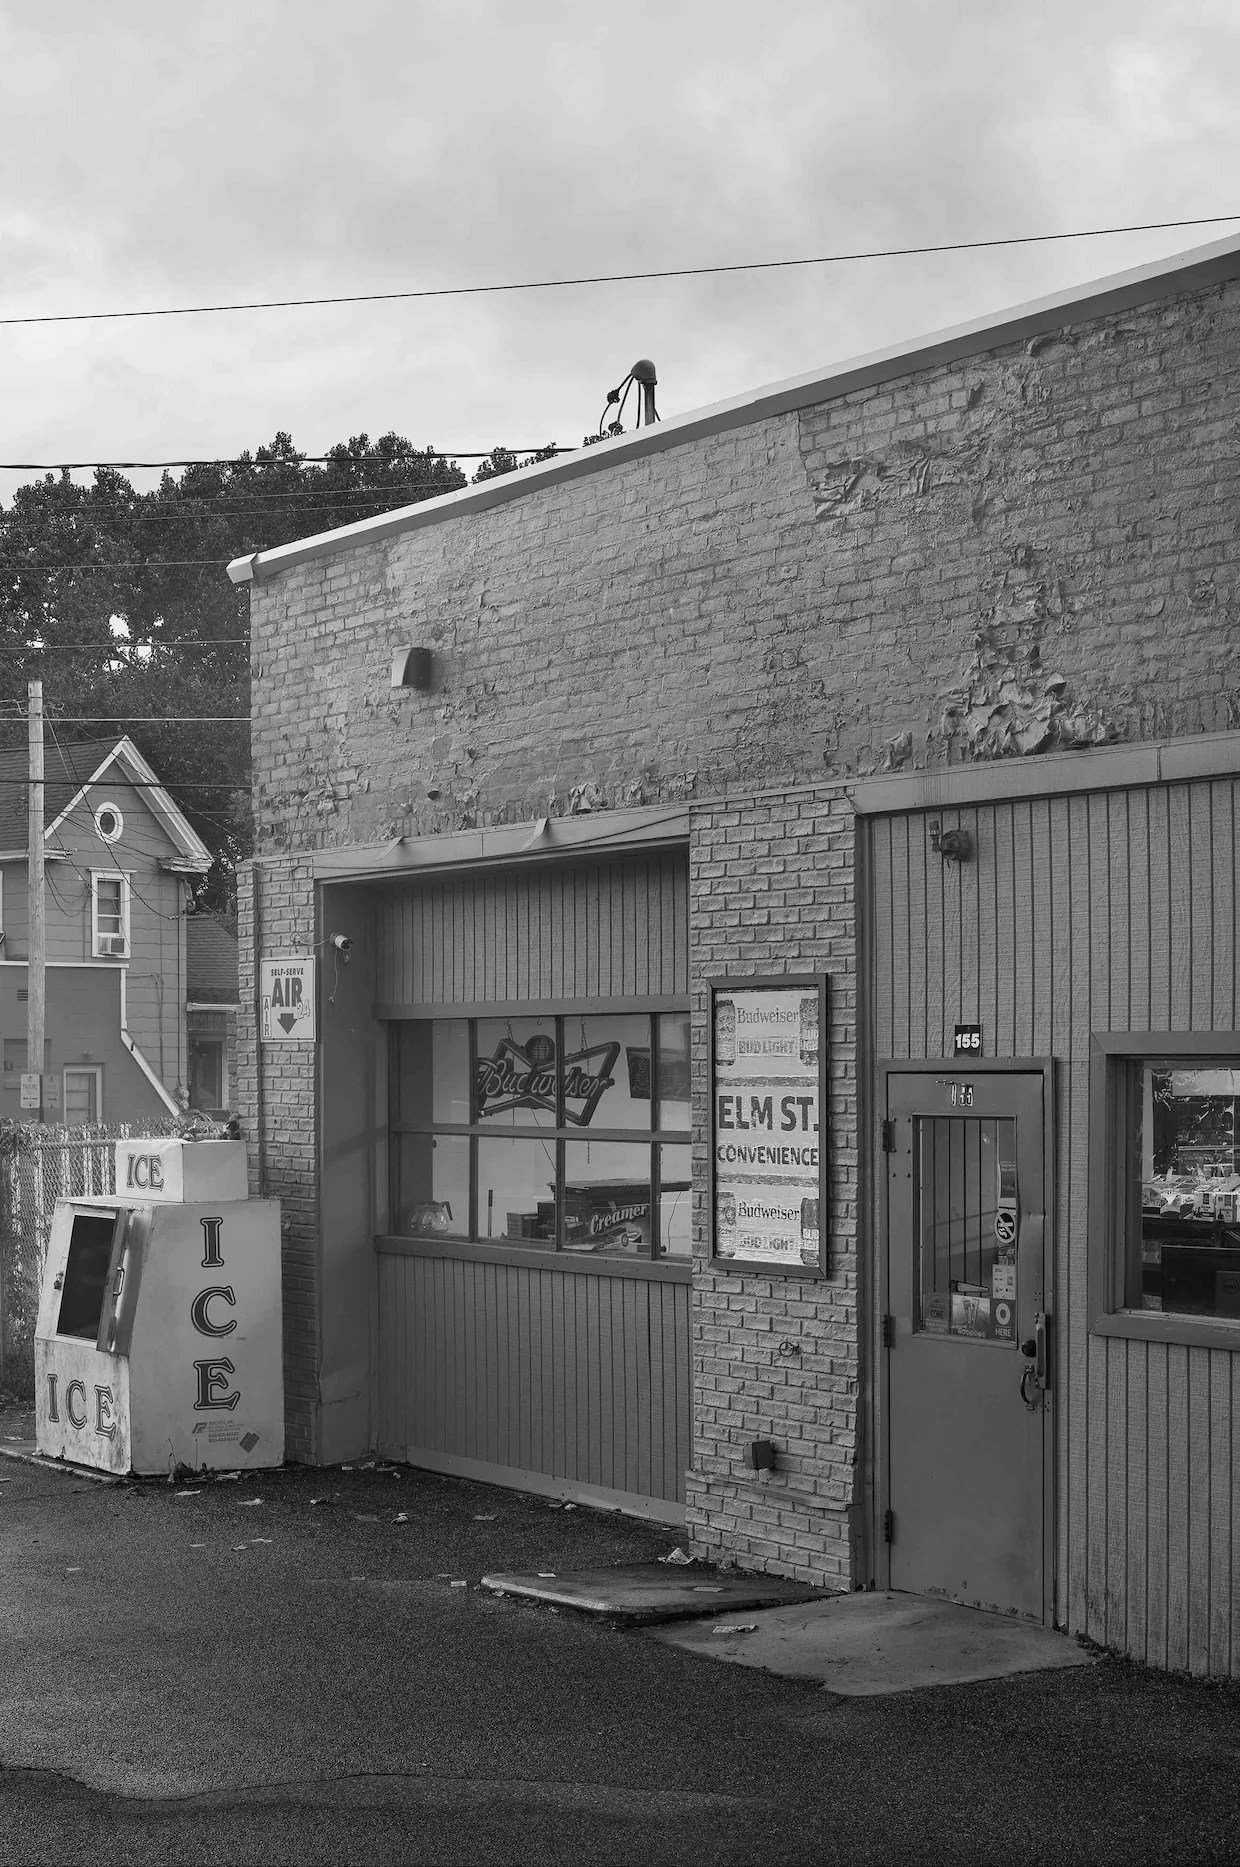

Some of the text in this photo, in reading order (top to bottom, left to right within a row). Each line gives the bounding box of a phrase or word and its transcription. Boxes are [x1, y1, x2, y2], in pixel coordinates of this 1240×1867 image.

[270, 967, 304, 976] SELF-SERVE
[271, 977, 303, 1008] AIR
[737, 1007, 799, 1024] Budweiser
[738, 1040, 762, 1054] BUD
[762, 1040, 796, 1054] LIGHT
[955, 1033, 980, 1049] 155
[718, 1095, 820, 1132] ELM ST.
[717, 1145, 820, 1167] CONVENIENCE
[126, 1153, 164, 1192] ICE
[590, 1204, 647, 1236] Creamer
[738, 1201, 801, 1221] Budweiser
[190, 1216, 241, 1412] ICE
[995, 1328, 1012, 1337] HERE
[46, 1373, 117, 1439] ICE
